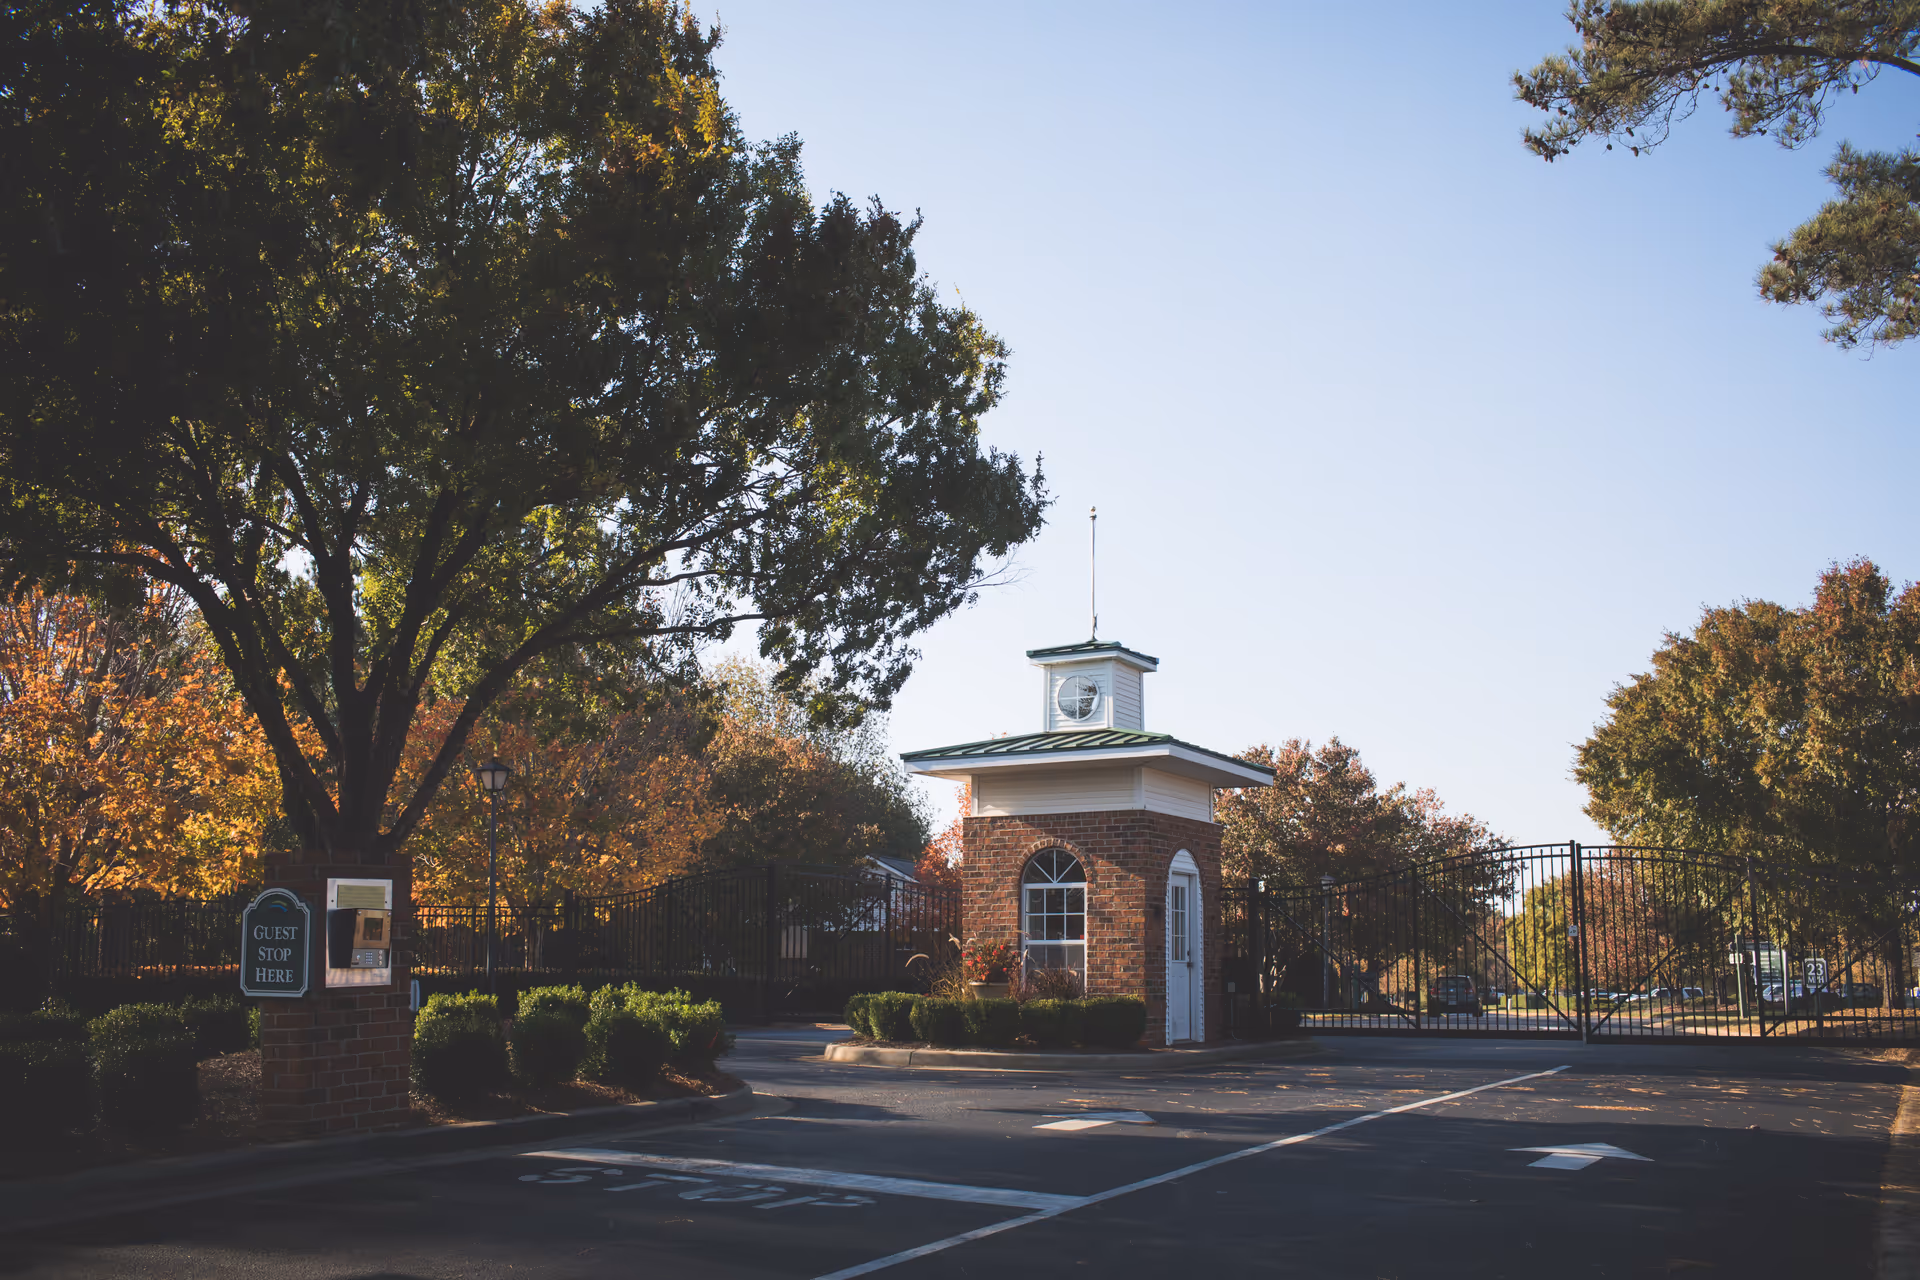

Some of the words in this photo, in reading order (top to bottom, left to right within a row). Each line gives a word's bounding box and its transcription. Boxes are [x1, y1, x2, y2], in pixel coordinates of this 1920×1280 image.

[253, 925, 298, 940] GUEST
[258, 946, 292, 962] STOP
[255, 967, 294, 983] HERE
[1807, 963, 1824, 976] 23
